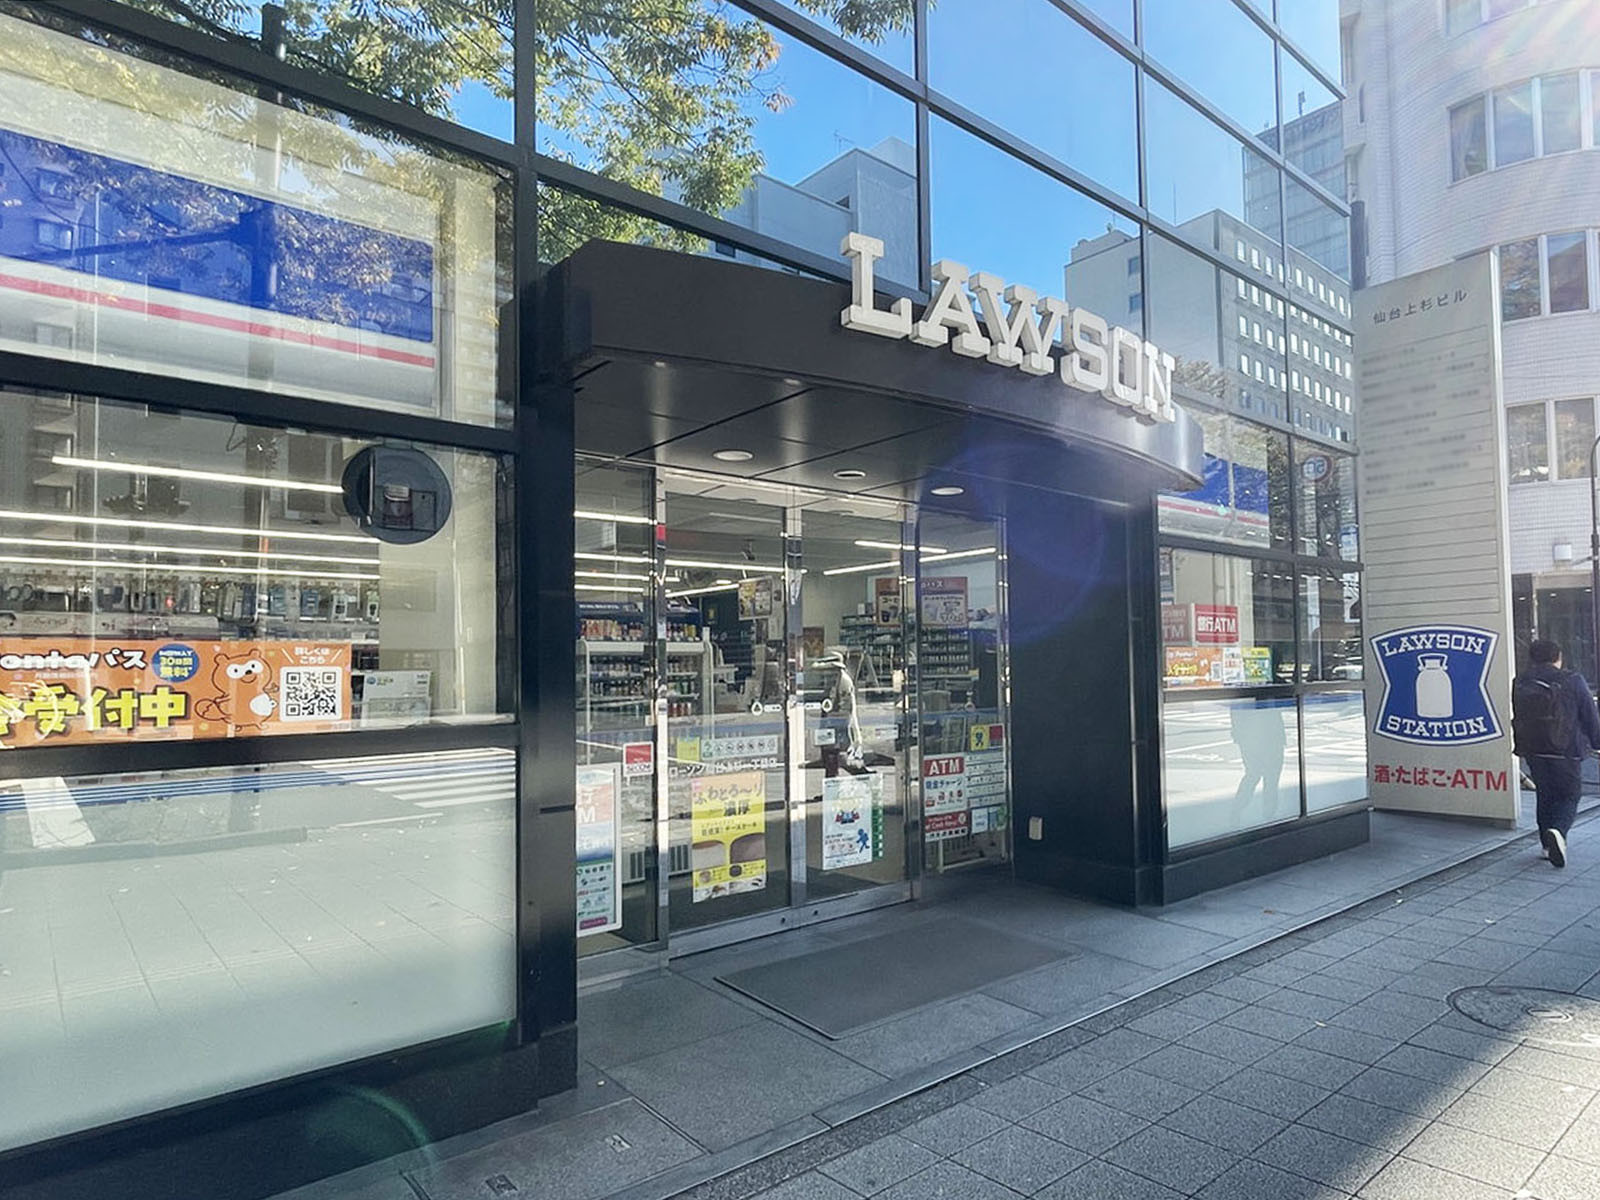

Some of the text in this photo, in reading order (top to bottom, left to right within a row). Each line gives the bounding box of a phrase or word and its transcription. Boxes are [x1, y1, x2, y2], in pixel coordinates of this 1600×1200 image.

[1373, 289, 1467, 325] 仙台上杉ビル
[841, 232, 1176, 423] LAWSON
[1382, 633, 1486, 657] LAWSON
[0, 684, 189, 736] 受付中
[1387, 715, 1488, 738] STATION
[929, 759, 961, 776] ATM
